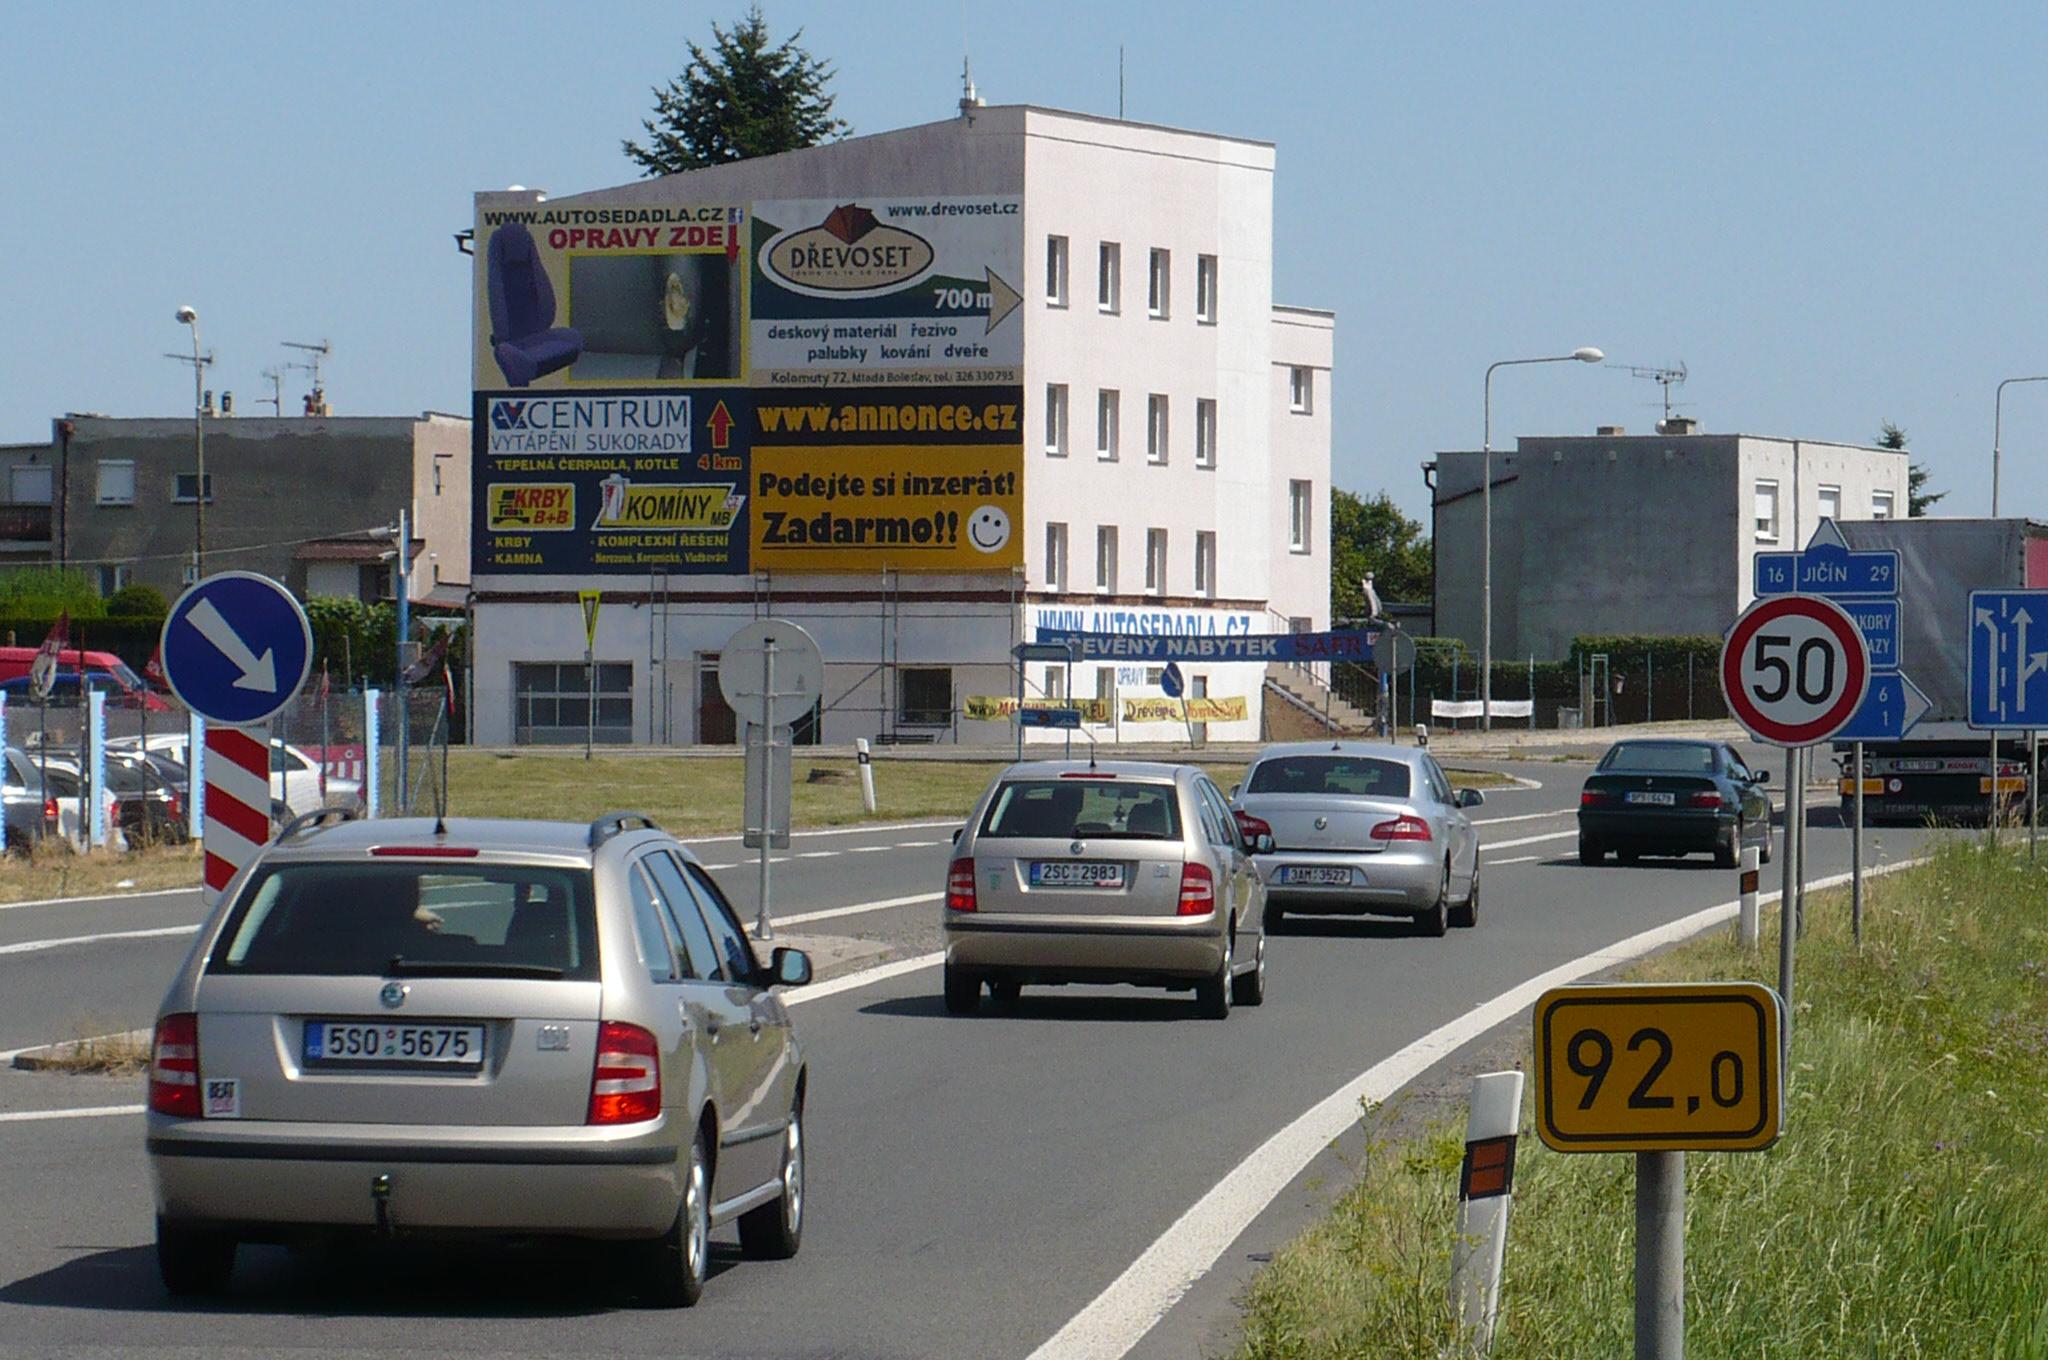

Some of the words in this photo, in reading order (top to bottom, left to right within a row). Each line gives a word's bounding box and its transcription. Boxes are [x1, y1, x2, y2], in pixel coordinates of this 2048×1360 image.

[484, 208, 723, 226] WWW.AUTOSEDADLA.CZ
[888, 202, 1019, 218] www.drevoset.cz
[549, 227, 660, 250] OPRAVY
[669, 225, 723, 247] ZDE
[791, 242, 912, 269] DŘEVOSET
[934, 289, 973, 309] 700
[976, 293, 994, 308] m
[768, 323, 830, 342] deskový
[833, 323, 898, 339] materiál
[910, 323, 958, 338] řezivo
[808, 345, 868, 363] palubky
[881, 345, 931, 359] kování
[945, 343, 989, 359] dveře
[771, 372, 829, 388] Kolomuty
[528, 400, 688, 429] CENTRUM
[757, 404, 1018, 433] www.annonce.cz
[491, 430, 577, 451] VYTÁPĚNÍ
[586, 432, 689, 450] SUKORADY
[496, 458, 555, 472] TEPELNÁ
[558, 457, 631, 473] ČERPADLA,
[634, 458, 679, 471] KOTLE
[697, 454, 709, 471] 4
[712, 454, 743, 471] km
[759, 472, 865, 500] Podejte
[872, 472, 896, 497] si
[903, 470, 1015, 497] inzerát!
[514, 488, 569, 508] KRBY
[534, 510, 569, 525] B+B
[626, 490, 712, 520] KOMÍNY
[711, 512, 731, 526] MB
[762, 511, 959, 544] Zadarmo!!
[495, 537, 532, 548] KRBY
[598, 534, 677, 547] KOMPLEXNÍ
[495, 552, 544, 564] KAMNA
[1767, 566, 1785, 583] 16
[1803, 561, 1848, 583] JIČÍN
[1870, 565, 1890, 582] 29
[1853, 614, 1892, 630] KORY
[1752, 635, 1835, 705] 50
[1879, 688, 1888, 702] 6
[1882, 711, 1889, 726] 1
[1043, 864, 1070, 879] 2SC
[1081, 865, 1117, 880] 2983
[402, 1028, 470, 1057] 5675
[1566, 1027, 1745, 1116] 92,0
